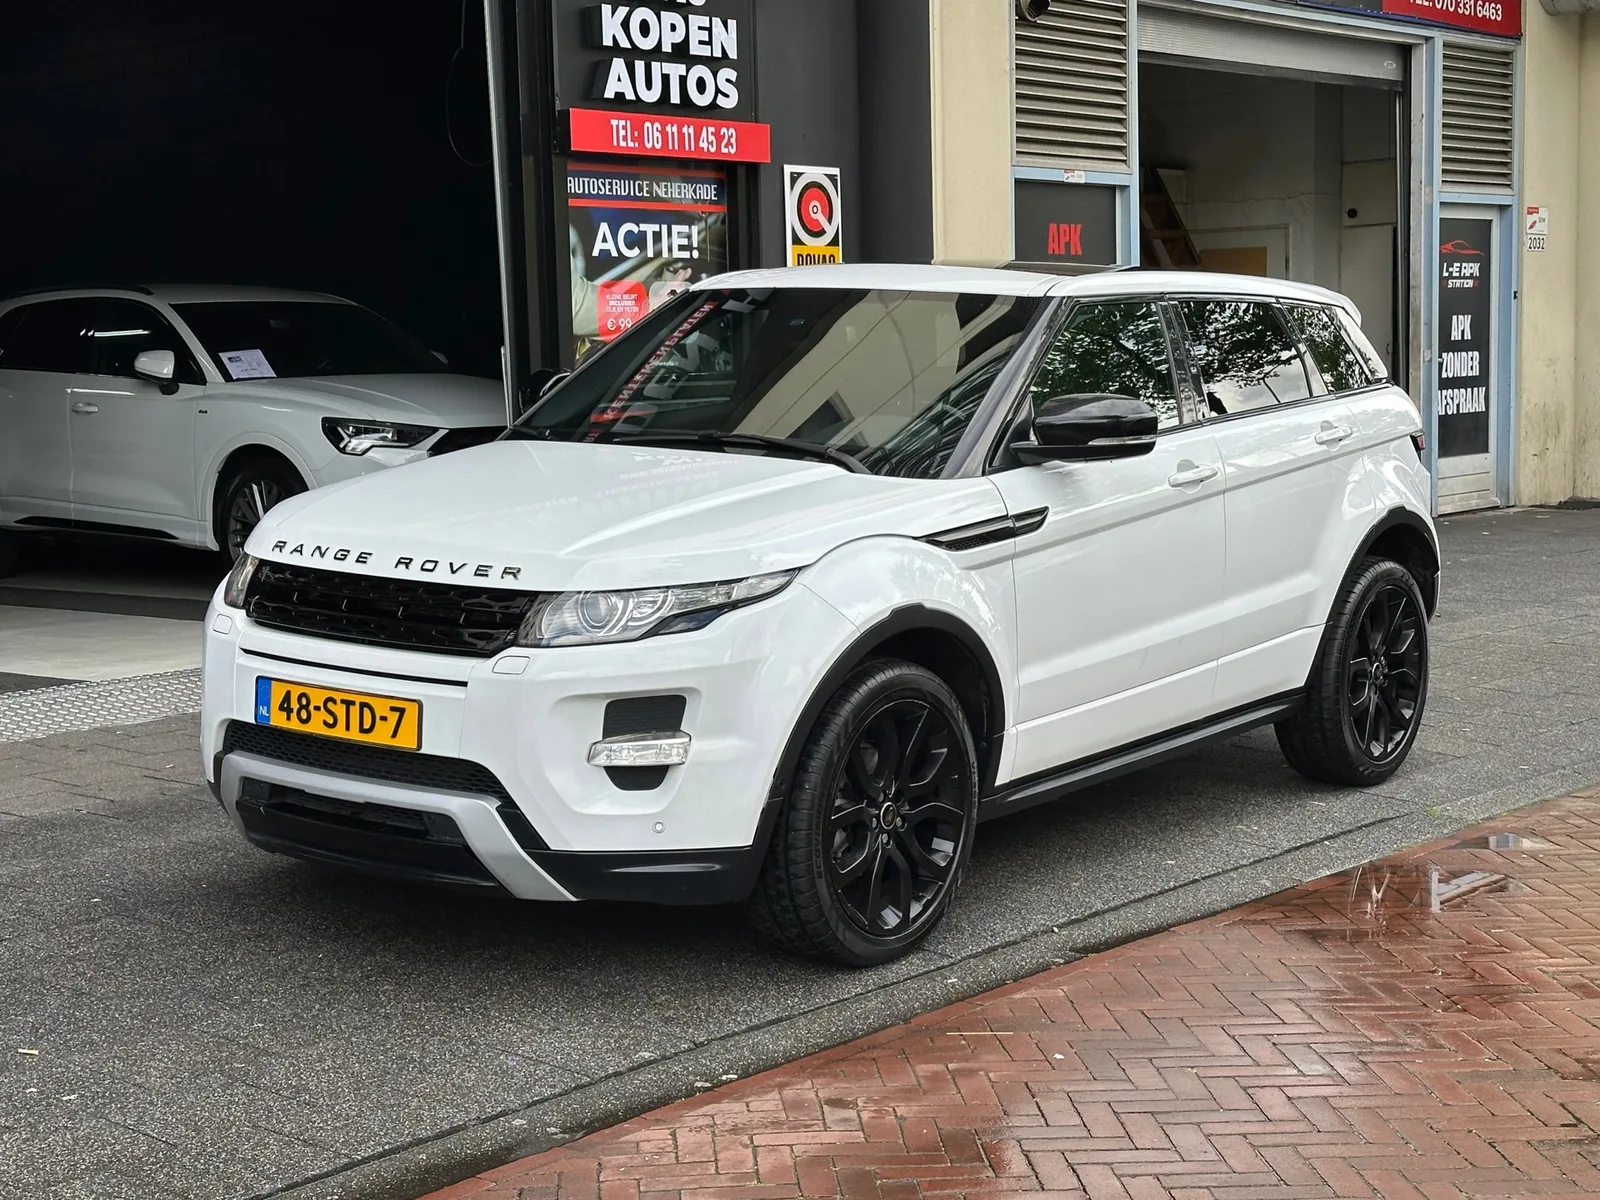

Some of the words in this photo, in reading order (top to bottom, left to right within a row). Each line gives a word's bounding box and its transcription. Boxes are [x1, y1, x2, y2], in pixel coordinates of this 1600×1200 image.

[1457, 0, 1474, 16] 331
[1476, 0, 1502, 21] 6463
[601, 4, 738, 59] KOPEN
[603, 57, 739, 109] AUTOS
[610, 119, 638, 148] TEL:
[643, 121, 662, 149] 06
[665, 123, 678, 150] 11
[682, 124, 695, 152] 11
[699, 126, 717, 153] 45
[720, 127, 736, 154] 23
[653, 181, 718, 200] NEHERKADE
[592, 221, 700, 259] ACTIE!
[1047, 223, 1082, 256] APK
[1528, 236, 1545, 250] 2032
[1442, 262, 1460, 277] L-E
[1460, 262, 1480, 277] APK
[1447, 279, 1474, 289] STATION
[606, 317, 617, 331] €
[618, 317, 632, 331] 99
[1450, 314, 1472, 341] APK
[1441, 350, 1480, 379] ZONDER
[271, 540, 373, 565] RANGE
[394, 556, 522, 580] ROVER
[259, 705, 270, 717] NL
[277, 689, 407, 739] 48-STD-7
